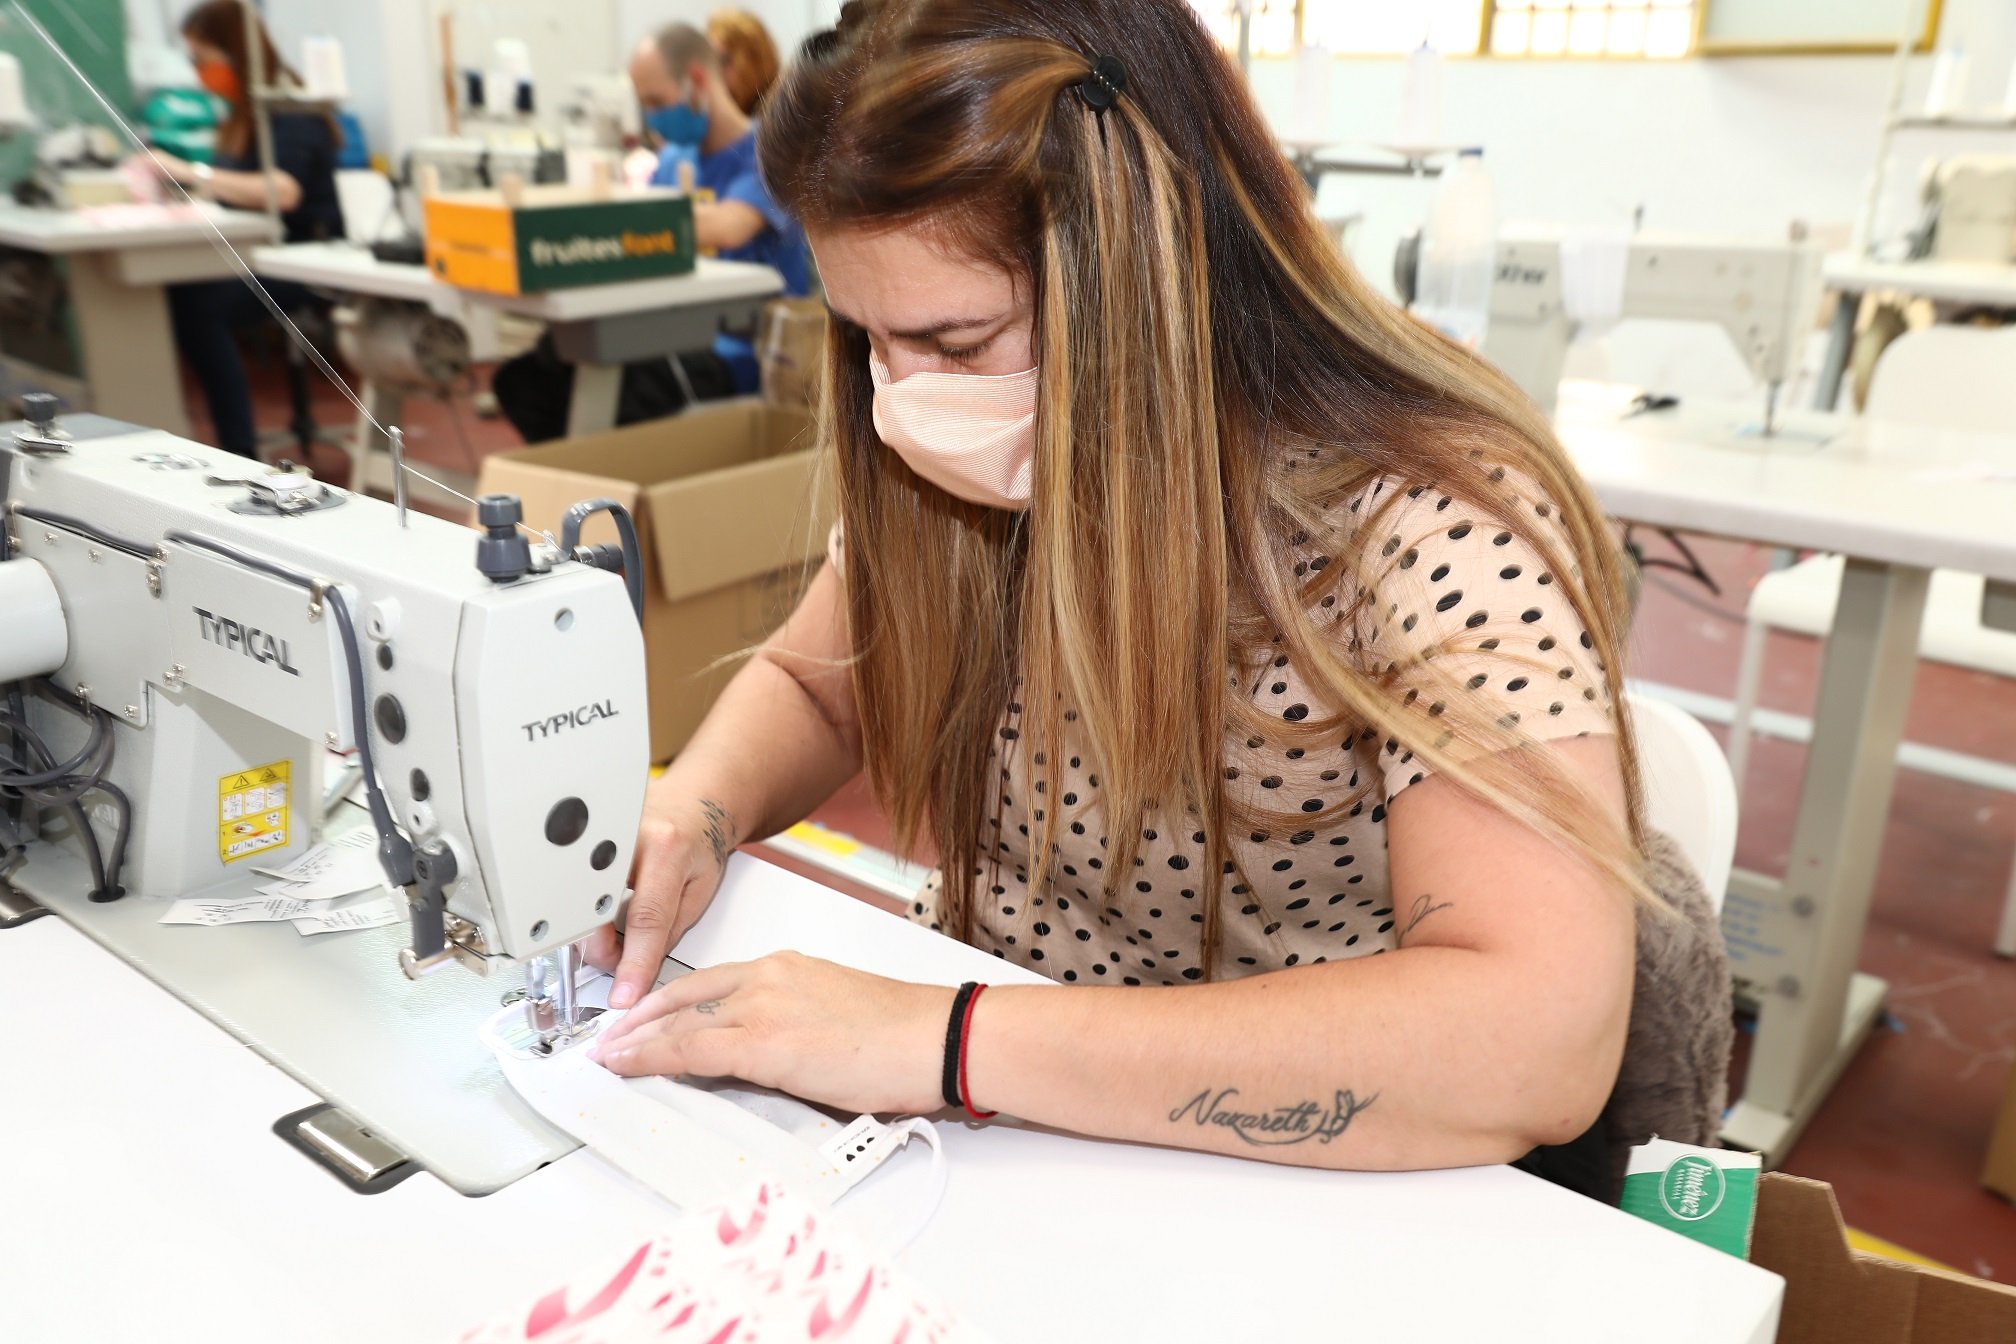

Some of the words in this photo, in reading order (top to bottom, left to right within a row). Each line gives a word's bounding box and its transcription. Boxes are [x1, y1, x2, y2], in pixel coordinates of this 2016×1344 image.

[191, 605, 300, 677] TYPICAL
[521, 698, 619, 741] TYPICAL
[1168, 1087, 1321, 1146] Nazareth
